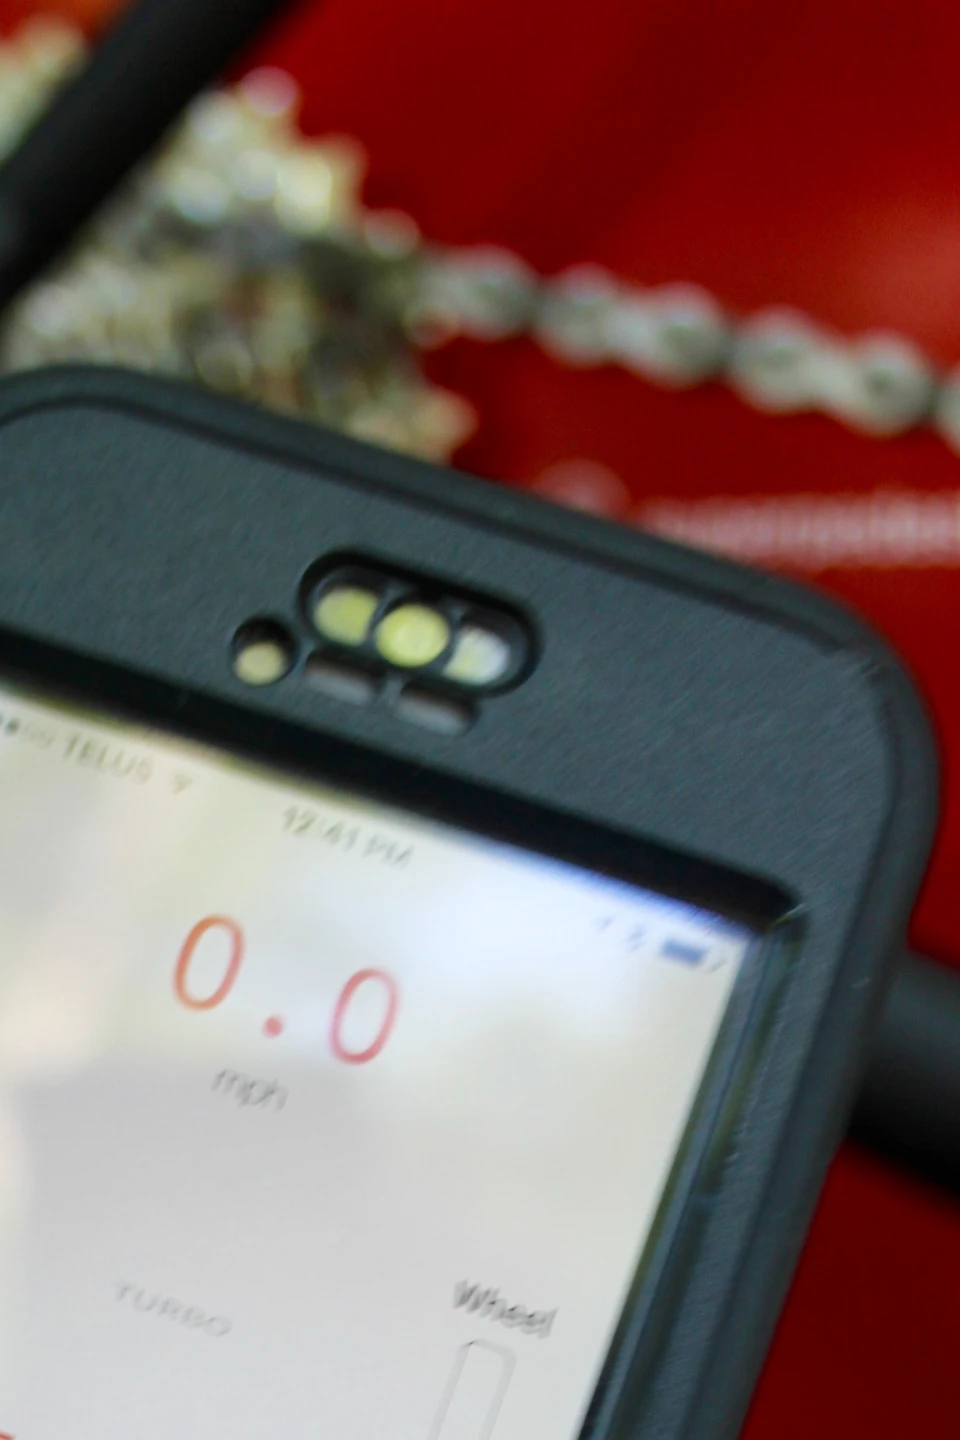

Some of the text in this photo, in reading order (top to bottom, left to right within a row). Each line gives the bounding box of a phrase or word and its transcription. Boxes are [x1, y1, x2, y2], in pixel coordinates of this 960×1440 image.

[63, 733, 152, 783] TELUS
[281, 804, 414, 869] 12:41 PM
[173, 914, 400, 1065] 0.0
[210, 1066, 289, 1112] mph
[111, 1279, 233, 1338] TURBO
[452, 1277, 557, 1340] Wheel
